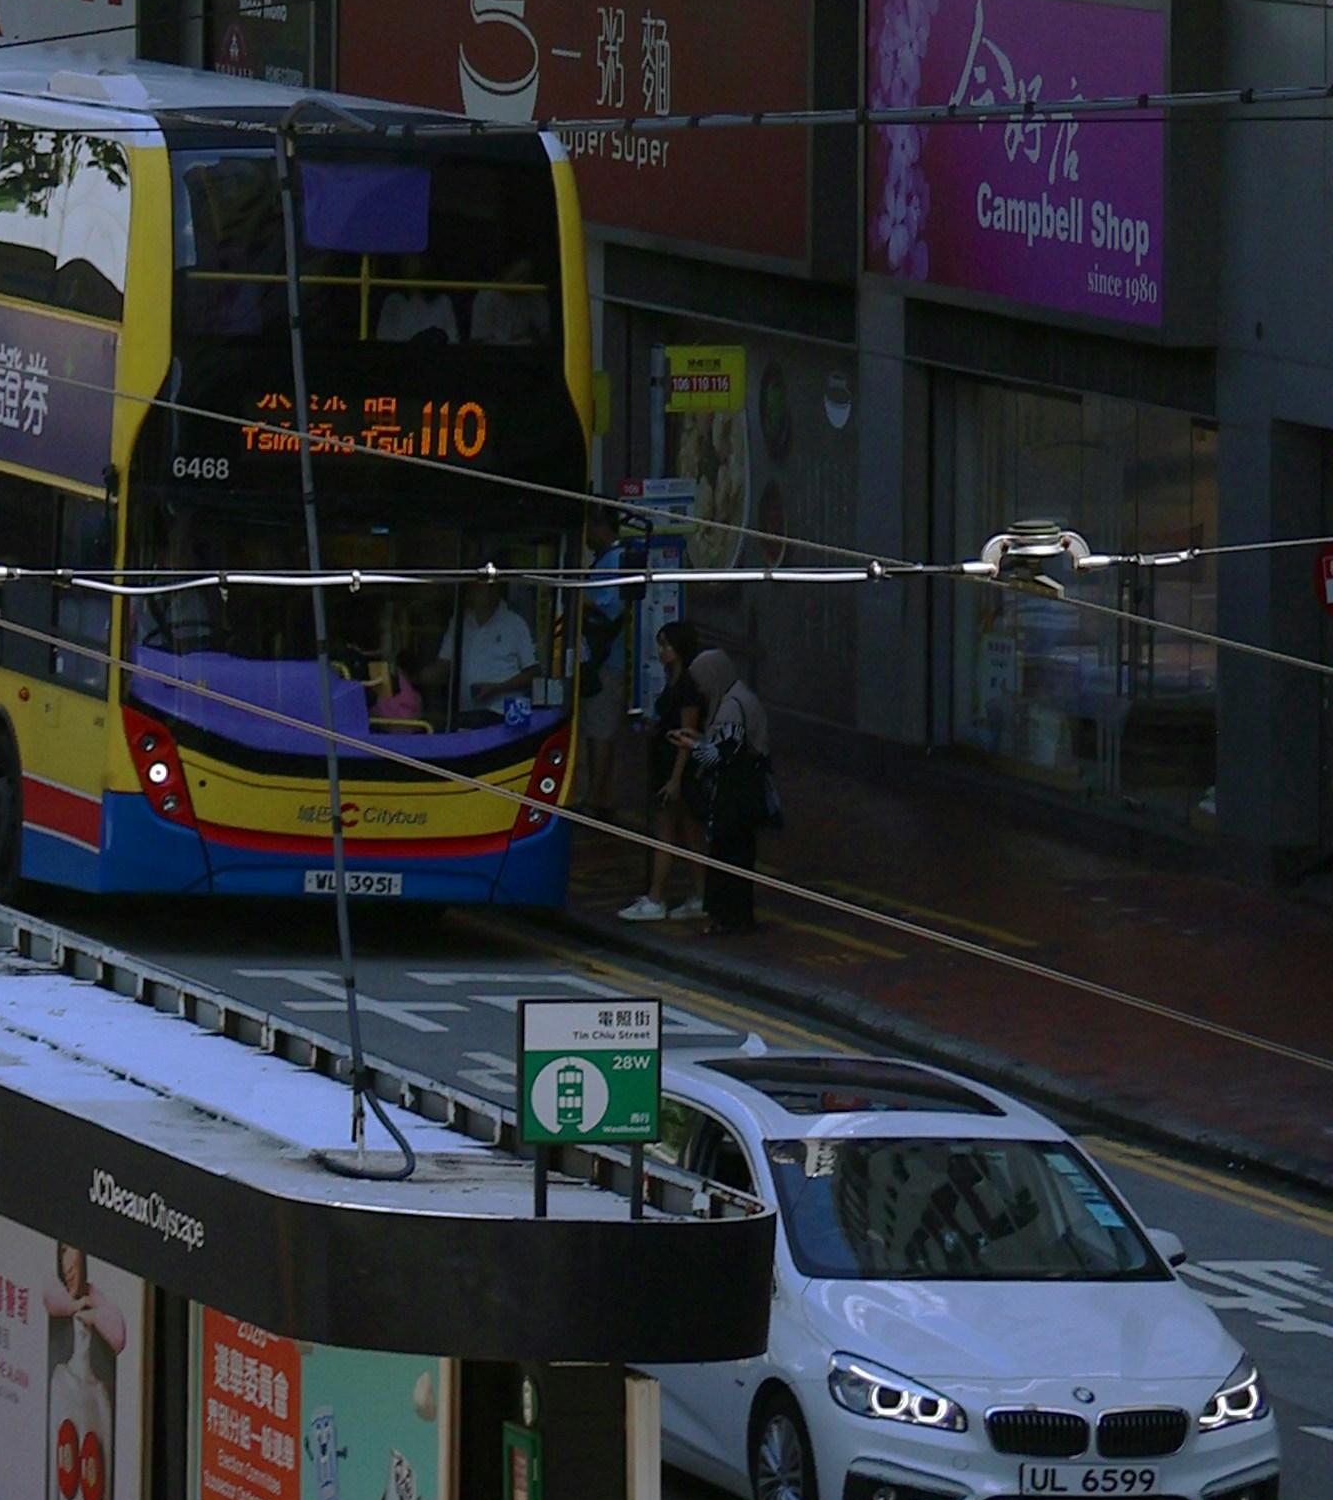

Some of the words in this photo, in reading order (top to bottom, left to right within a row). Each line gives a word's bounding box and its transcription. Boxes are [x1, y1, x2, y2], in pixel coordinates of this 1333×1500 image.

[551, 5, 671, 117] 一粥麵
[612, 132, 670, 171] Super
[976, 181, 1083, 247] Campbell
[1090, 200, 1150, 267] Shop
[1087, 263, 1122, 298] since
[1124, 271, 1158, 306] 1980
[419, 399, 488, 460] 110
[171, 456, 231, 481] 6468
[363, 806, 428, 826] Citybus
[349, 875, 392, 893] 3951
[598, 1010, 651, 1027] 電照街
[573, 1031, 589, 1040] Tin
[592, 1030, 615, 1040] Chiu
[618, 1030, 651, 1040] Street
[612, 1054, 651, 1071] 28W
[89, 1167, 150, 1226] JCDecaux
[148, 1191, 205, 1253] Cityscape
[1031, 1468, 1067, 1492] UL
[1082, 1469, 1155, 1492] 6599
